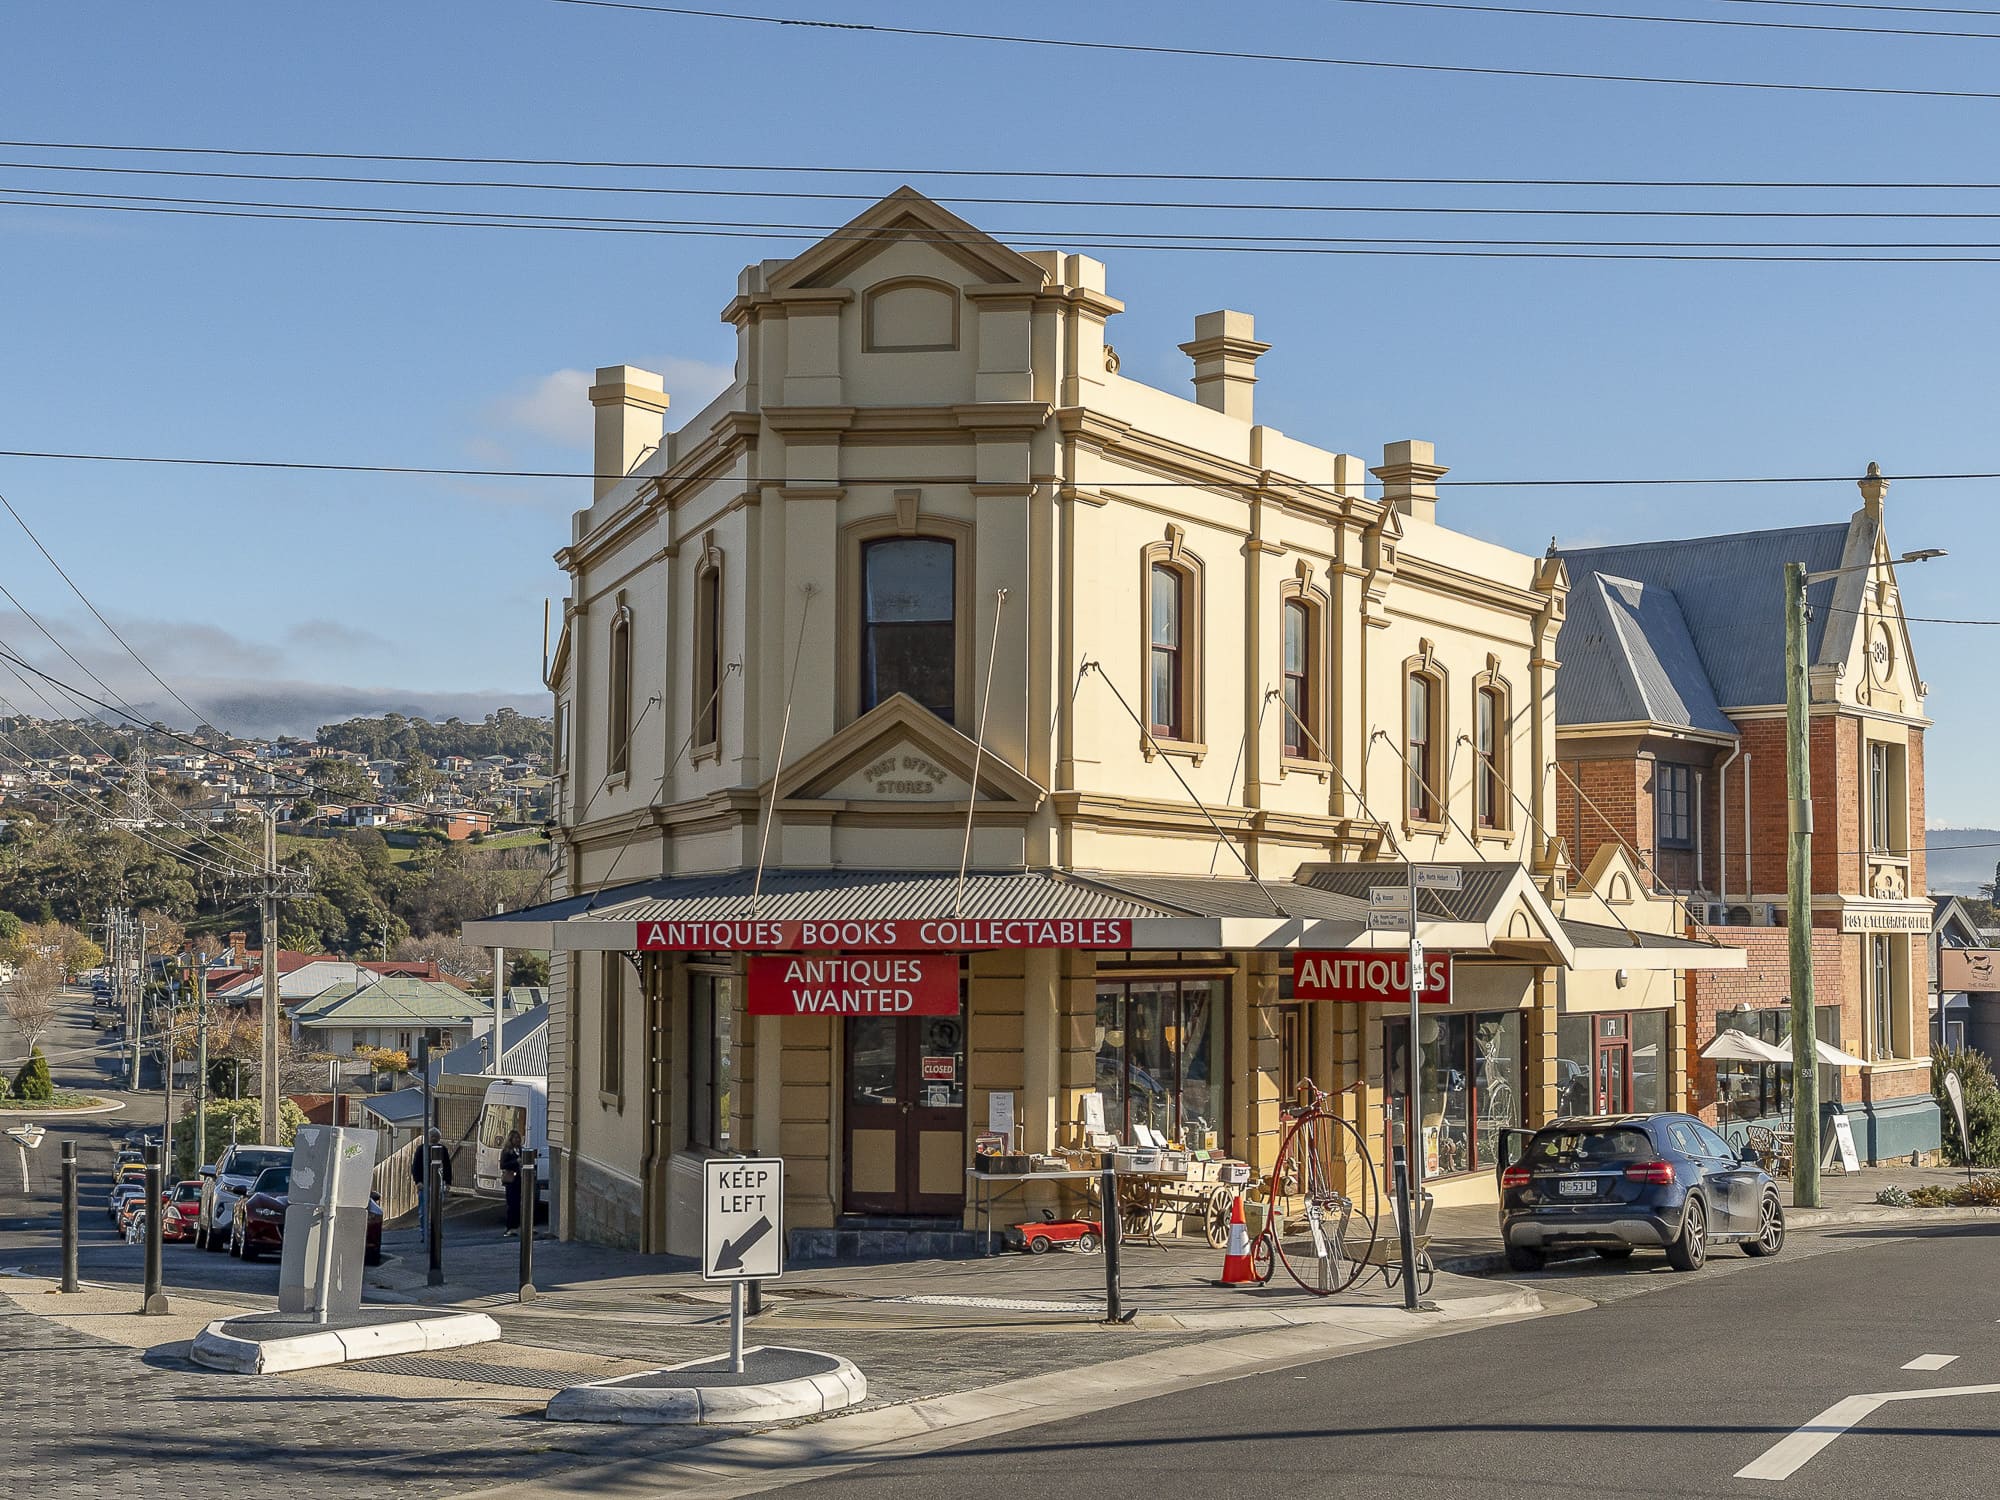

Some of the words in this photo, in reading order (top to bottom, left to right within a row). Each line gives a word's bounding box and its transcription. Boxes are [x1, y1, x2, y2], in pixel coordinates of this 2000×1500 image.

[863, 757, 897, 783] POST
[902, 756, 948, 784] OFFICE
[876, 780, 934, 794] STORES
[1844, 914, 1861, 928] POST
[1870, 915, 1907, 929] TELEGRAPH
[1908, 916, 1930, 929] OFFICE
[646, 922, 783, 948] ANTIQUES
[802, 922, 897, 945] BOOKS
[920, 921, 1122, 944] COLLECTABLES
[783, 960, 922, 986] ANTIQUES
[1297, 959, 1446, 995] ANTIQUS
[792, 989, 913, 1013] WANTED
[924, 1065, 953, 1074] CLOSED
[719, 1171, 768, 1189] KEEP
[720, 1194, 766, 1213] LEFT
